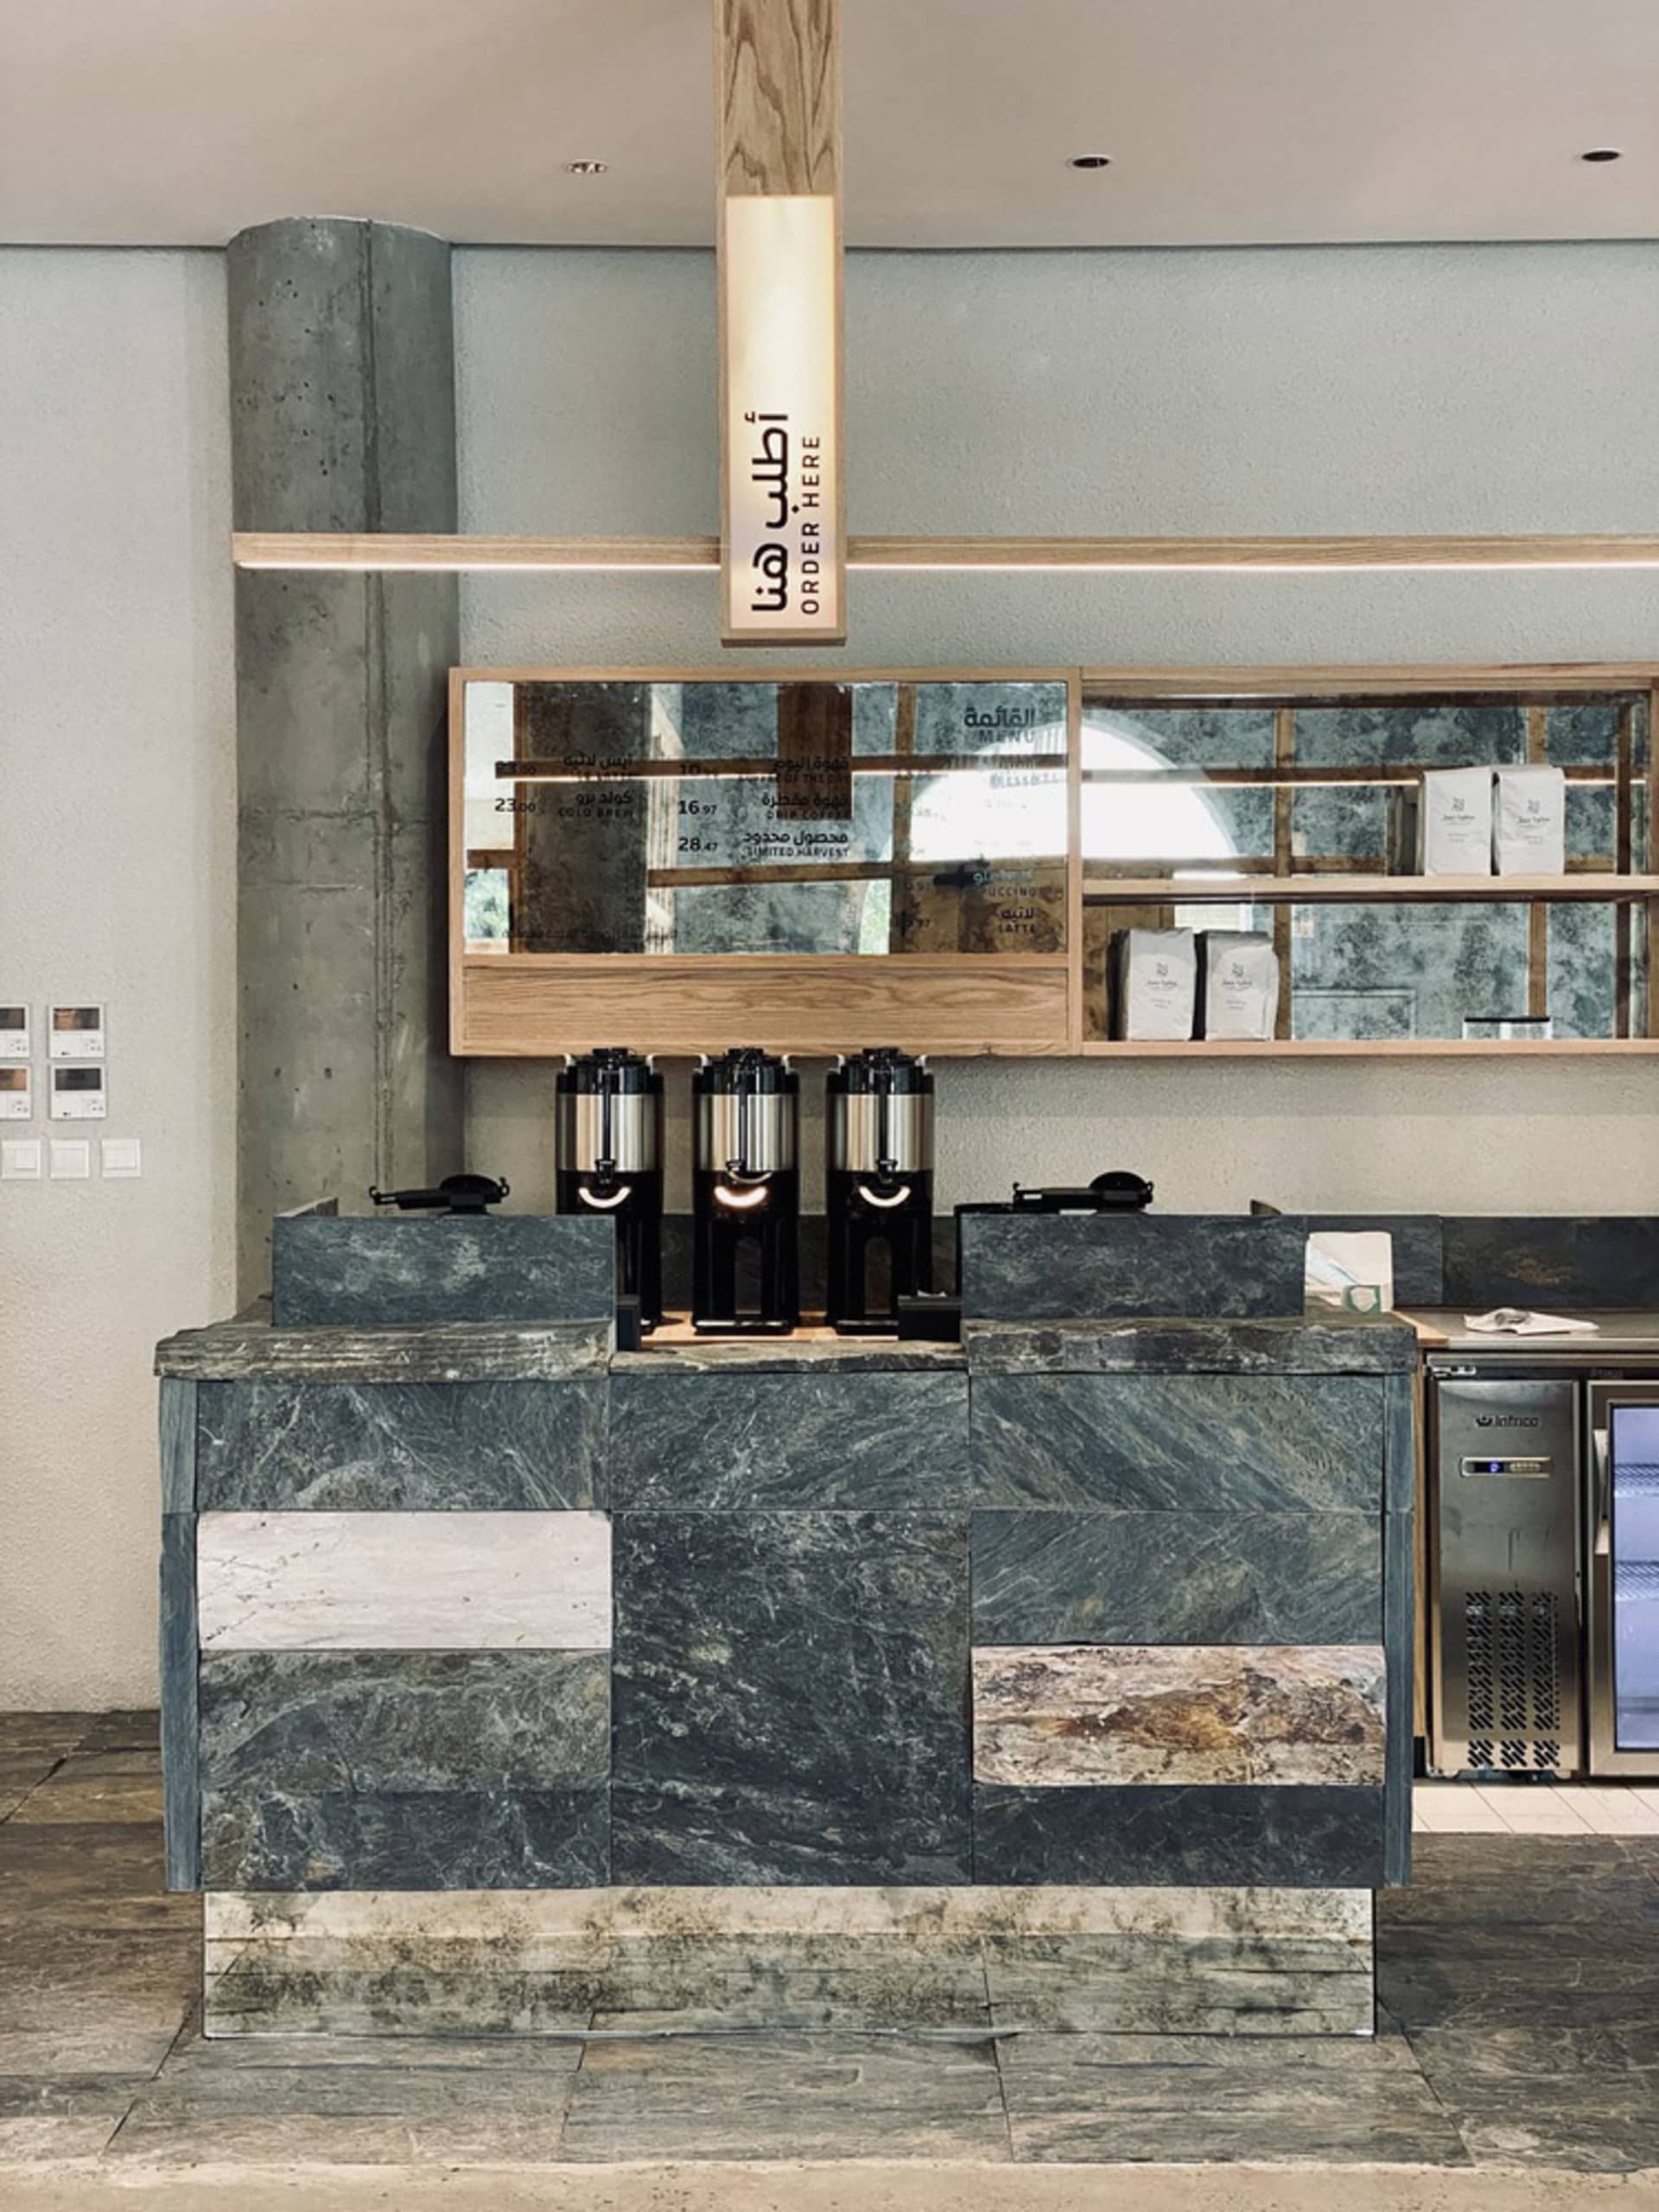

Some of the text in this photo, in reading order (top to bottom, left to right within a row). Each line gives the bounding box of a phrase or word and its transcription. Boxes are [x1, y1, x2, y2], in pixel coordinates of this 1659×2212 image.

[744, 411, 799, 612] أطلب هنا
[801, 436, 820, 614] ORDER HERE
[963, 705, 1036, 728] القائمة
[978, 729, 1035, 743] MENU
[557, 807, 592, 817] COLD
[743, 830, 849, 846] محصول محدود
